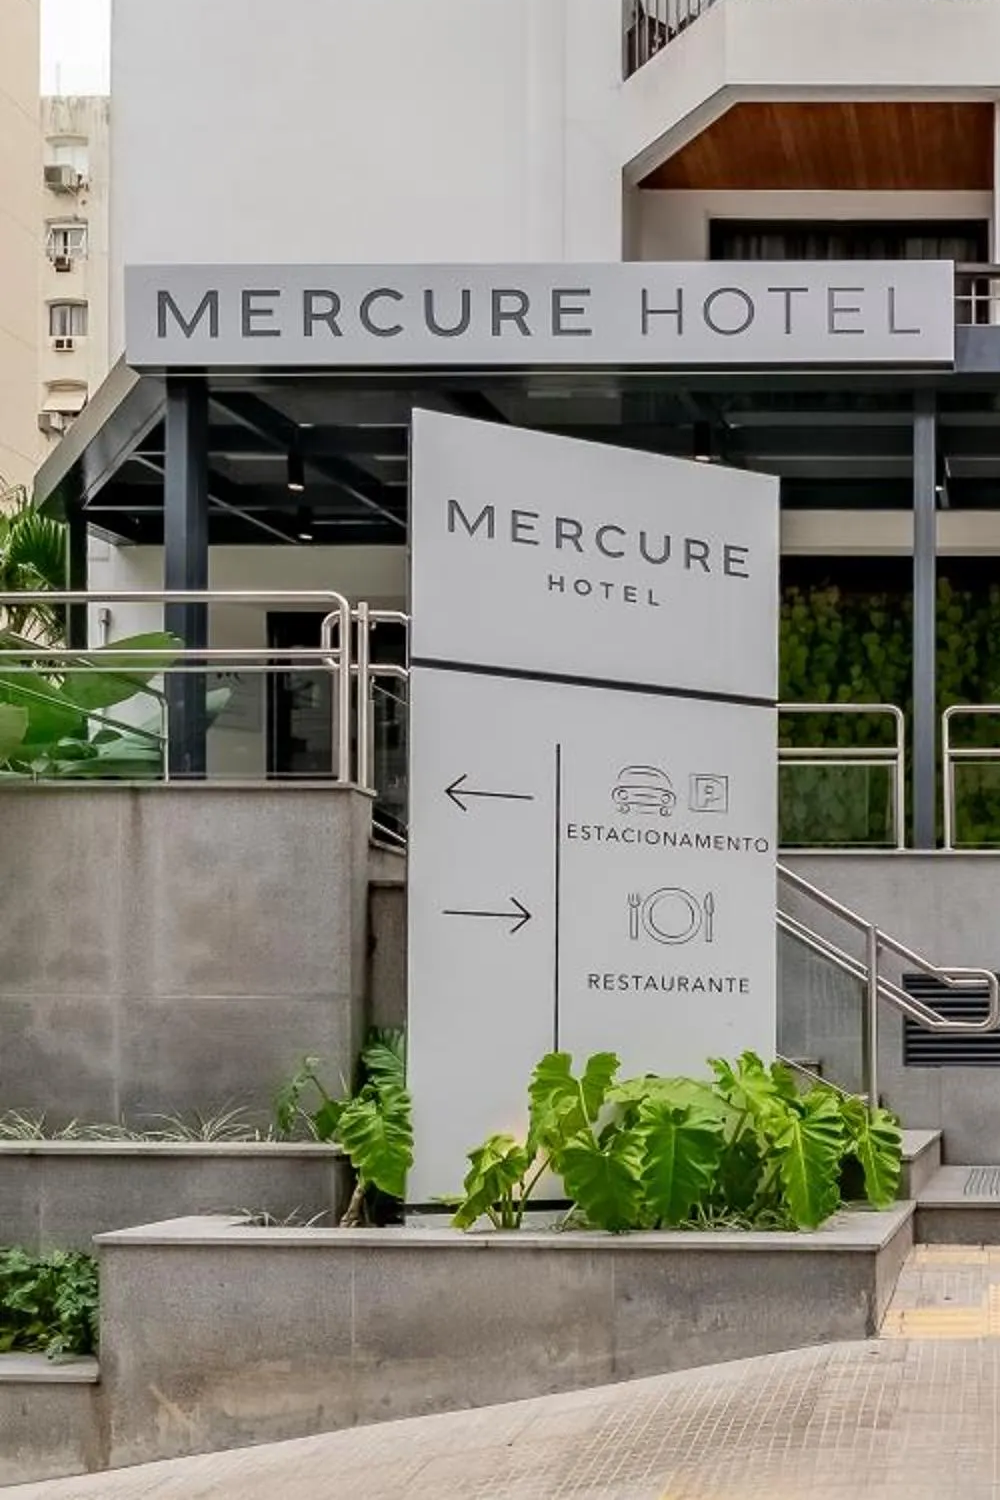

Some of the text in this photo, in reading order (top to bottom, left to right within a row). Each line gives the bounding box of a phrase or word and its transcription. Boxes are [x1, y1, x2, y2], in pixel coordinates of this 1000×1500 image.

[156, 286, 921, 339] MERCURE HOTEL
[447, 499, 750, 579] MERCURE
[548, 574, 660, 607] HOTEL
[696, 777, 724, 808] P
[566, 823, 770, 853] ESTACIONAMENTO
[587, 973, 750, 994] RESTAURANTE
